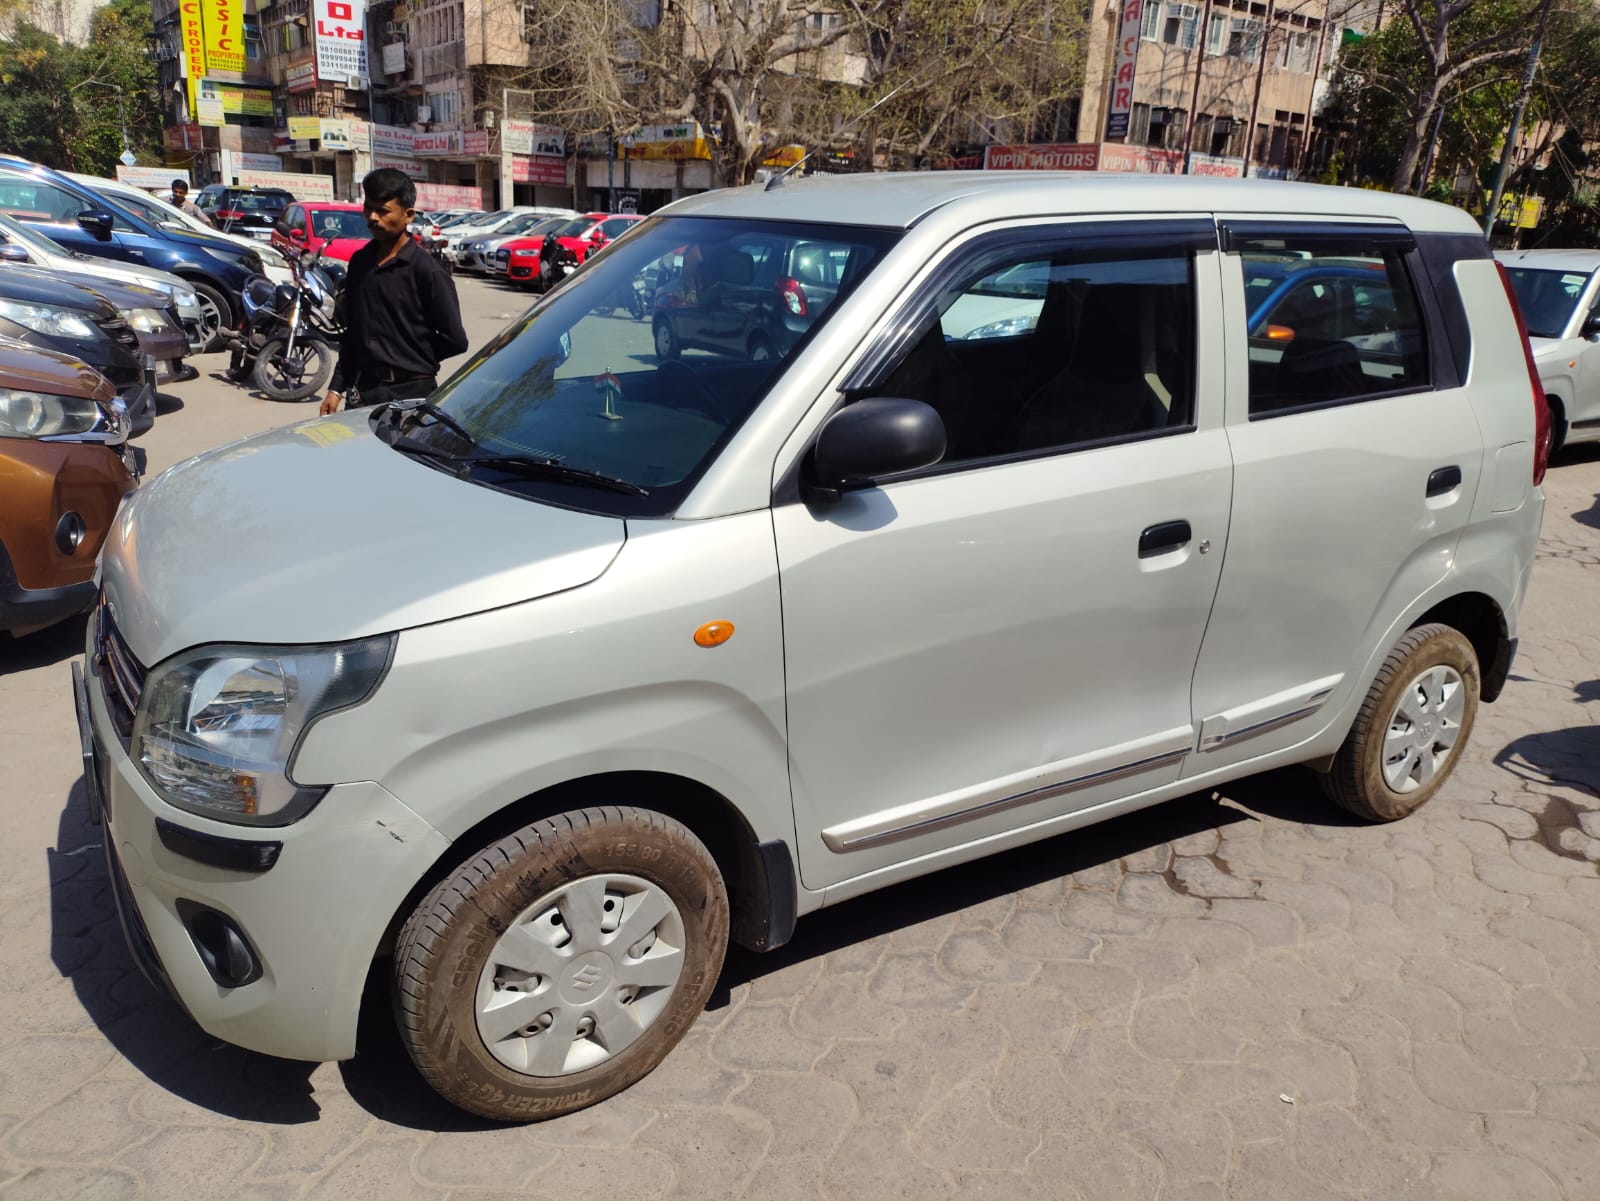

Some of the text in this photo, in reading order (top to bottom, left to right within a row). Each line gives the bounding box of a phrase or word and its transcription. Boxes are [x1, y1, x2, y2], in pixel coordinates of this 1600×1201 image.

[317, 20, 364, 40] Ltd
[1115, 36, 1135, 111] CAR
[991, 152, 1027, 168] VIPIN
[1030, 152, 1096, 168] MOTORS
[1103, 155, 1132, 170] VIPIN
